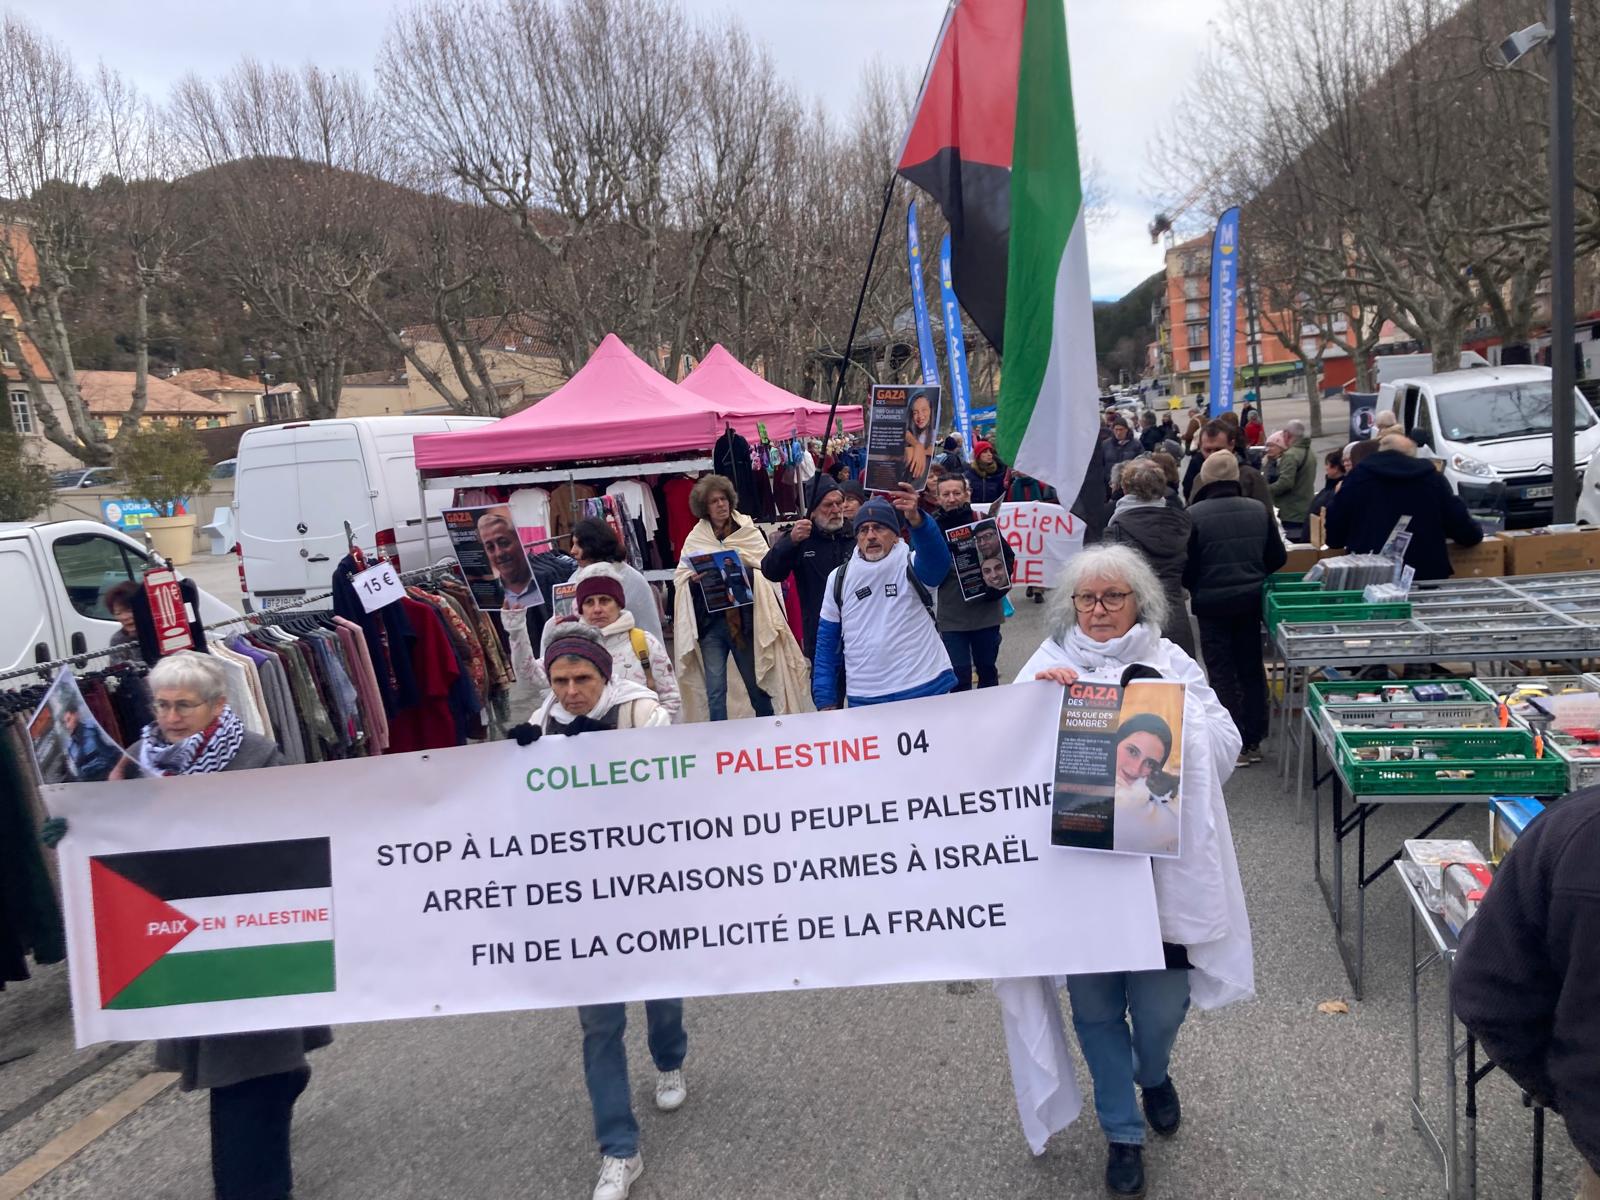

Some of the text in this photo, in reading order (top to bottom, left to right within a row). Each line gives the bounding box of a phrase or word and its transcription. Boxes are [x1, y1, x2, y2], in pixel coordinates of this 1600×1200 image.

[1218, 259, 1233, 408] La Marseillaise
[876, 389, 906, 400] GAZA
[446, 512, 473, 523] GAZA
[997, 507, 1073, 536] utieN
[949, 528, 971, 538] GAZA
[1007, 531, 1043, 555] AU
[363, 572, 394, 595] 15 €
[1067, 698, 1084, 706] DES
[1070, 684, 1118, 700] GAZA
[1065, 718, 1108, 728] NOMBRES
[1067, 711, 1113, 720] PAS QUE DES
[526, 729, 929, 792] COLLECTIF PALESTINE 04
[377, 840, 452, 867] STOP
[461, 833, 481, 860] À
[490, 835, 524, 859] LA
[530, 816, 734, 856] DESTRUCTION
[743, 812, 781, 836] DU
[791, 800, 899, 832] PEUPLE
[423, 835, 1039, 913] ARRÊT DES LIVRAISONS D'ARMES À ISRAËL
[147, 908, 329, 936] PAIX EN PALESTINE
[471, 903, 1007, 966] FIN DE LA COMPLICITÉ DE LA FRANCE
